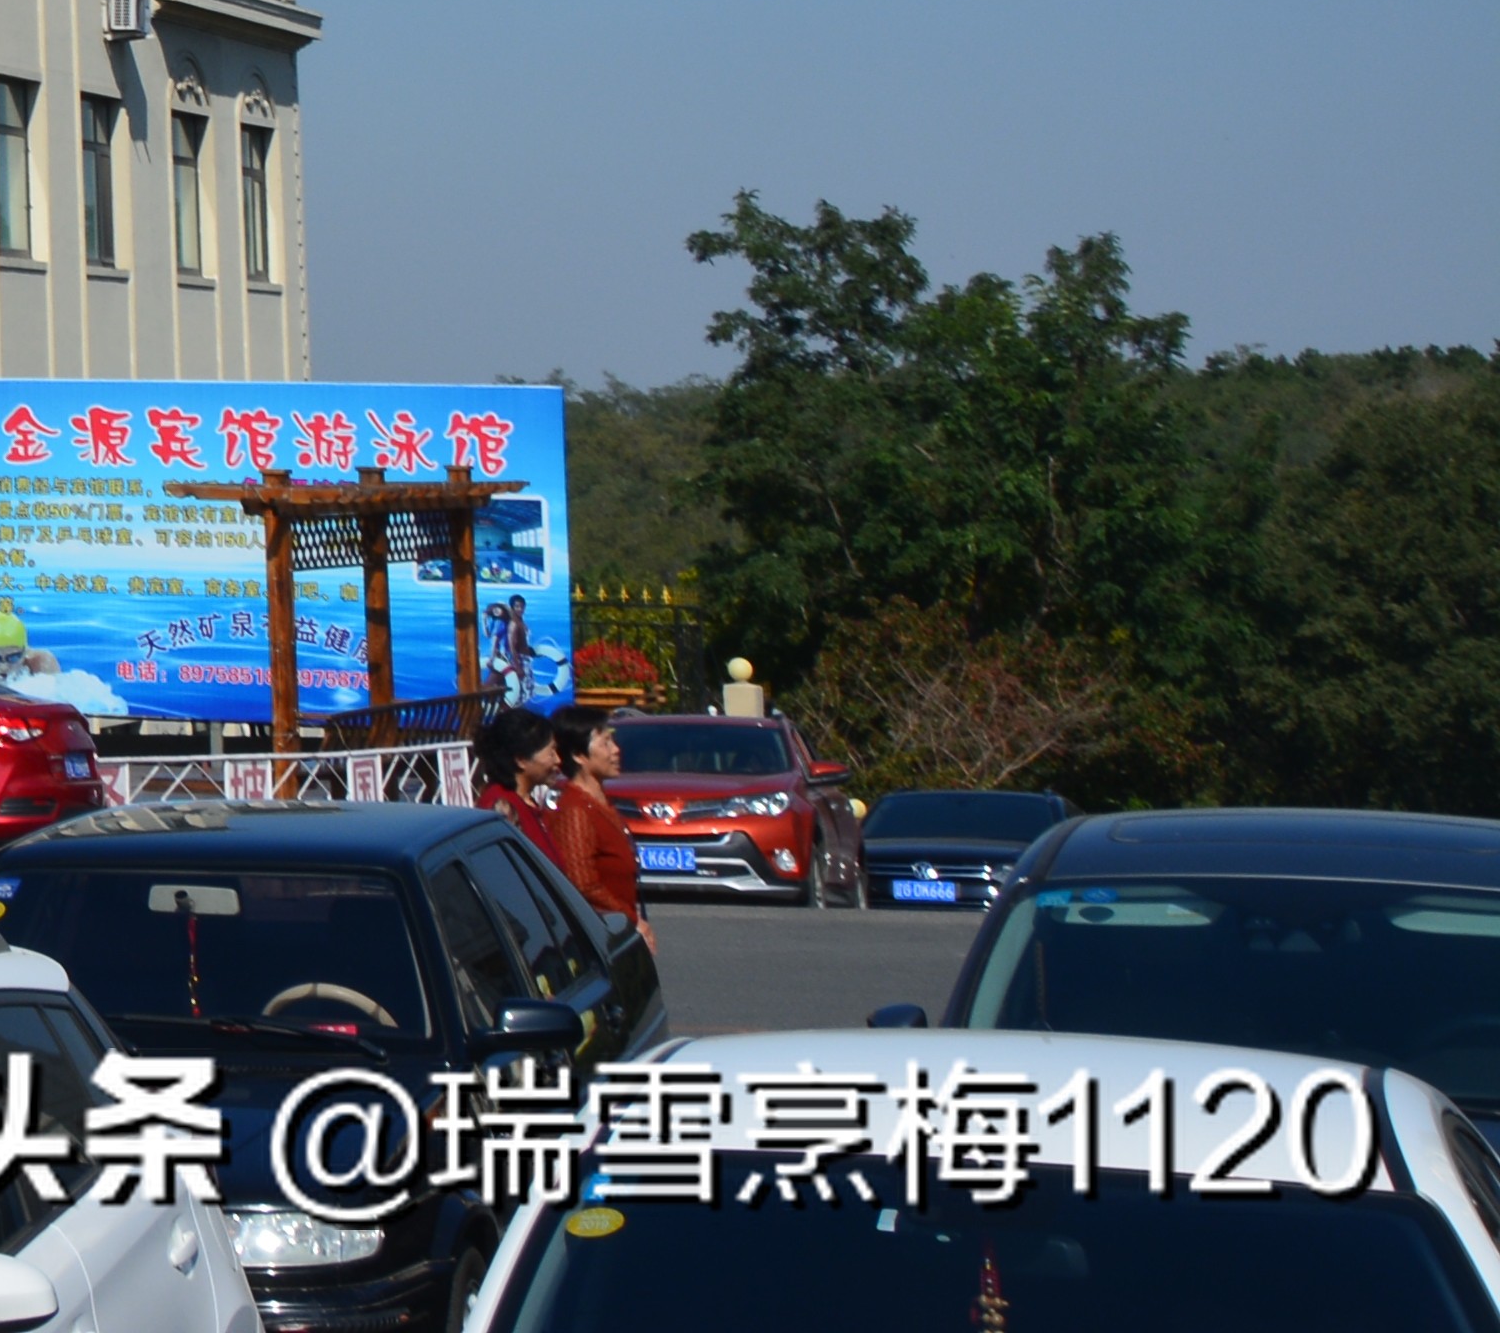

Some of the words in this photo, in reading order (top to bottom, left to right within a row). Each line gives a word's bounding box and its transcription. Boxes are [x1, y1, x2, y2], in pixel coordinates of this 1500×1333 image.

[2, 403, 513, 477] 金源宾馆游泳馆
[138, 611, 368, 664] 天然矿泉益健康
